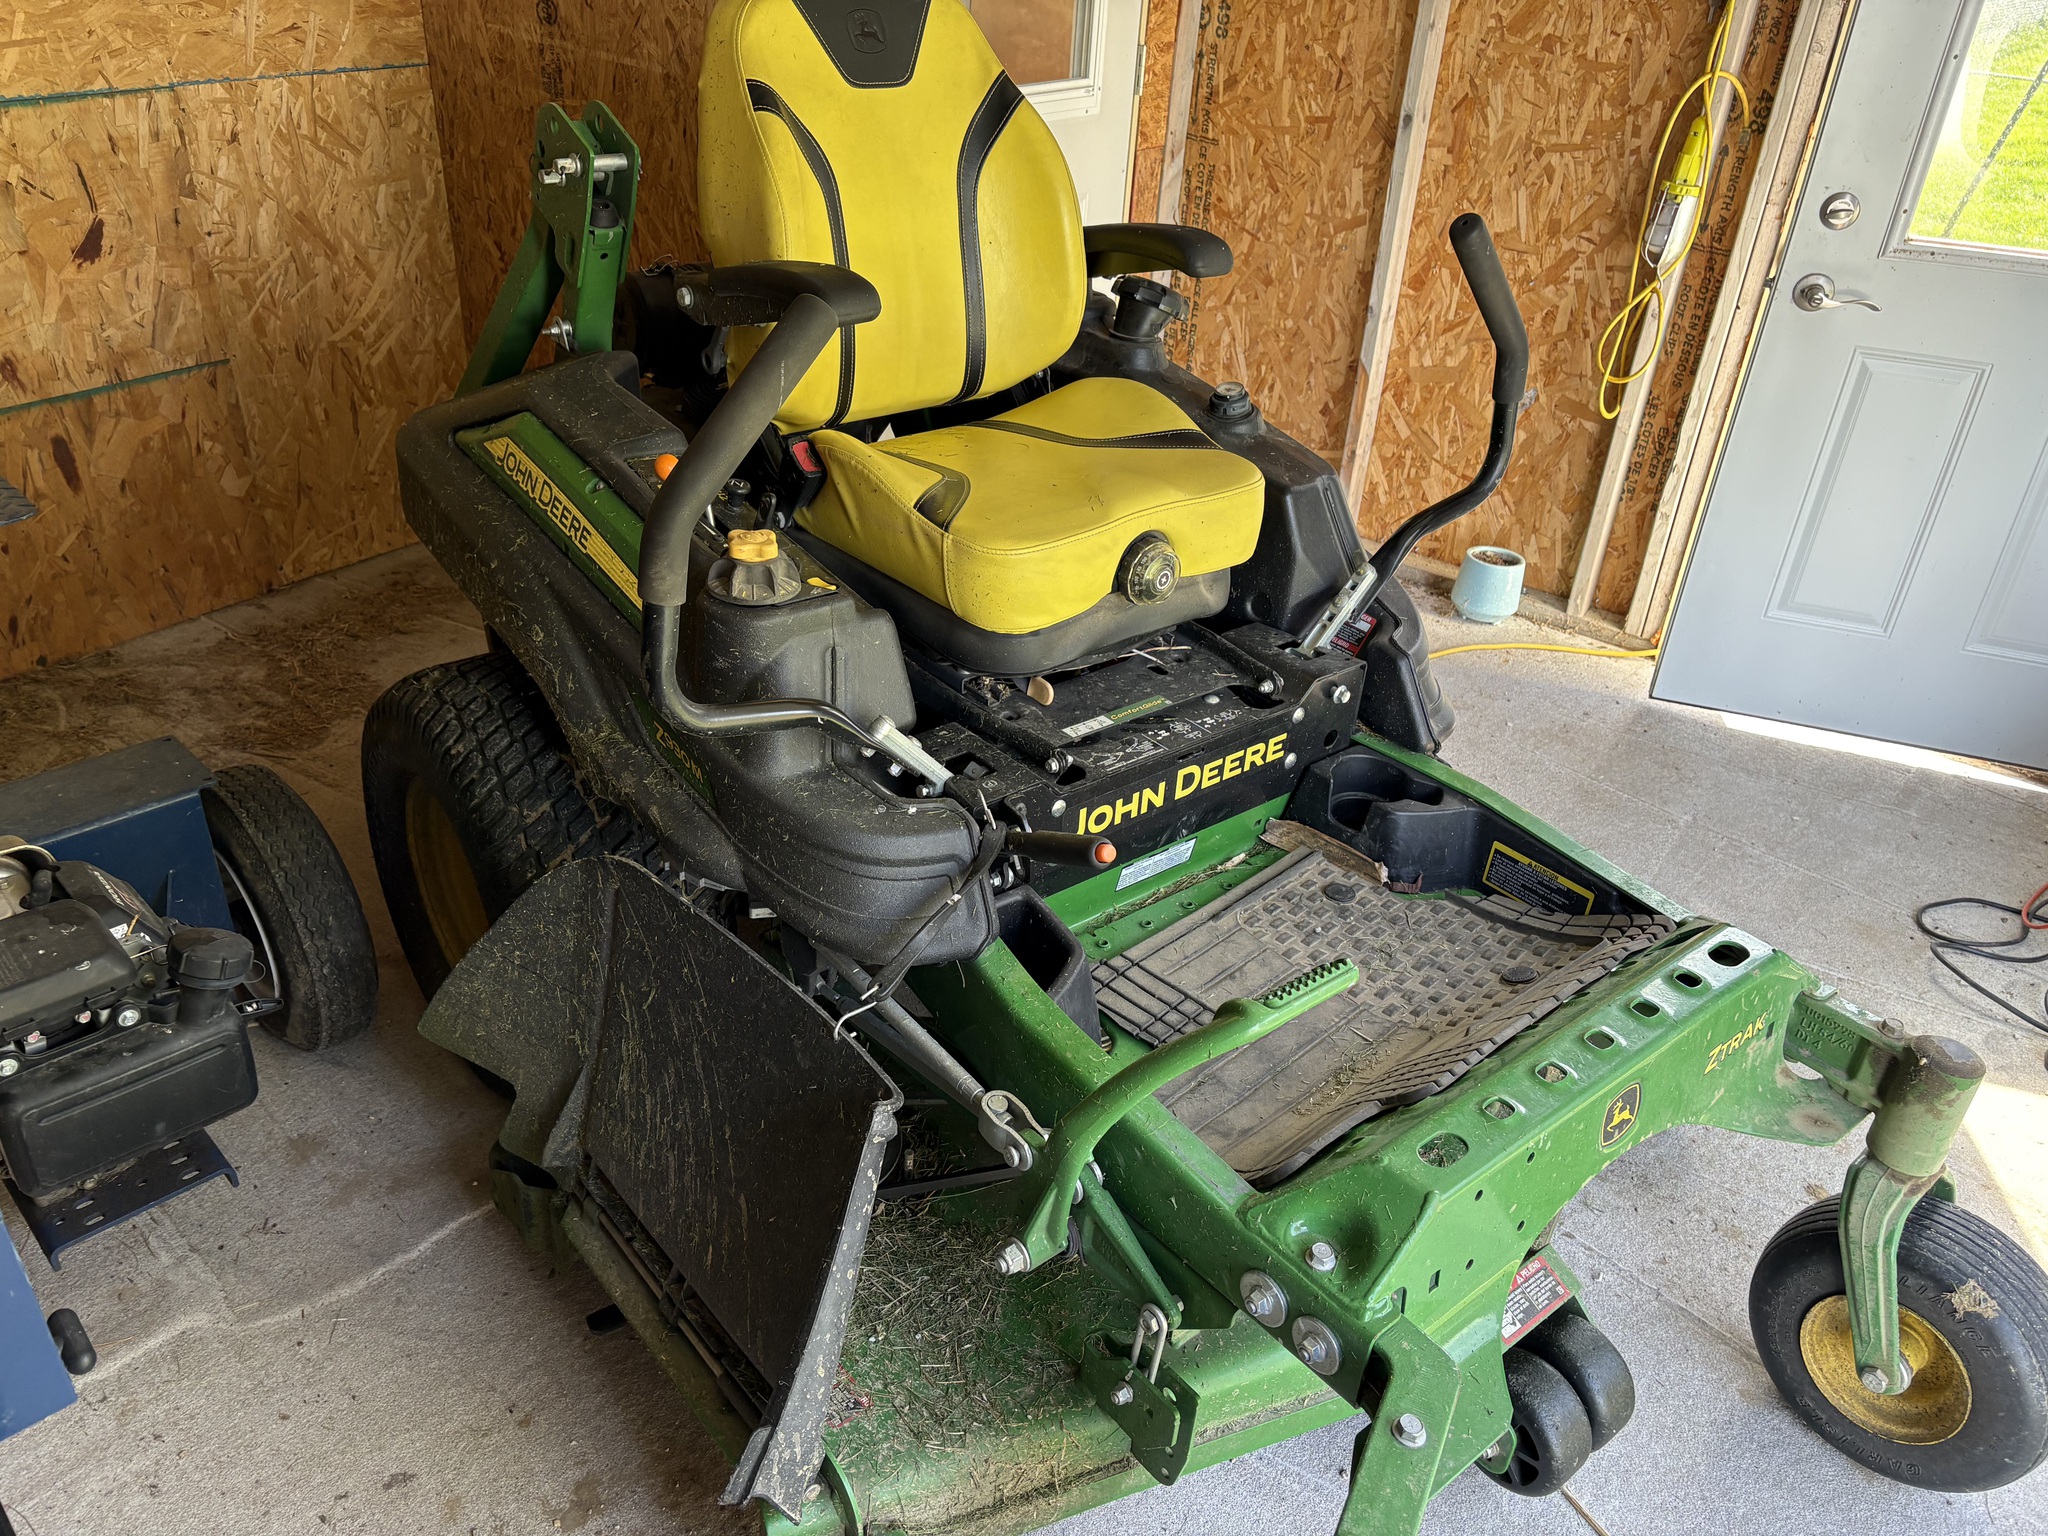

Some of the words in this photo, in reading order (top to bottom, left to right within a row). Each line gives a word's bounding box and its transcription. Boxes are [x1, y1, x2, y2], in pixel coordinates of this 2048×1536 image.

[1215, 0, 1231, 39] 498
[1204, 42, 1218, 105] STRENGTH
[1201, 109, 1211, 133] AXIS
[1199, 145, 1206, 160] CE
[1183, 169, 1192, 201] ROOF
[1195, 162, 1205, 193] COTE
[1721, 145, 1747, 212] TRENGTH
[1194, 195, 1202, 210] EN
[1711, 215, 1728, 244] AXIS
[1190, 300, 1199, 320] ALL
[1680, 284, 1692, 320] ROOF
[1694, 277, 1710, 311] COTE
[1664, 321, 1681, 357] CLIPS
[1690, 314, 1701, 331] EN
[1672, 333, 1696, 388] DESSOUS
[1649, 396, 1661, 420] LES
[1637, 420, 1653, 459] COTES
[1646, 426, 1669, 479] ESPACER
[1631, 460, 1641, 476] DE
[497, 442, 539, 497] JOHN
[538, 479, 592, 551] DEERE
[654, 720, 704, 784] Z930M
[1076, 781, 1166, 836] JOHN
[1174, 732, 1288, 801] DEERE
[1704, 1010, 1769, 1076] ZTRAK
